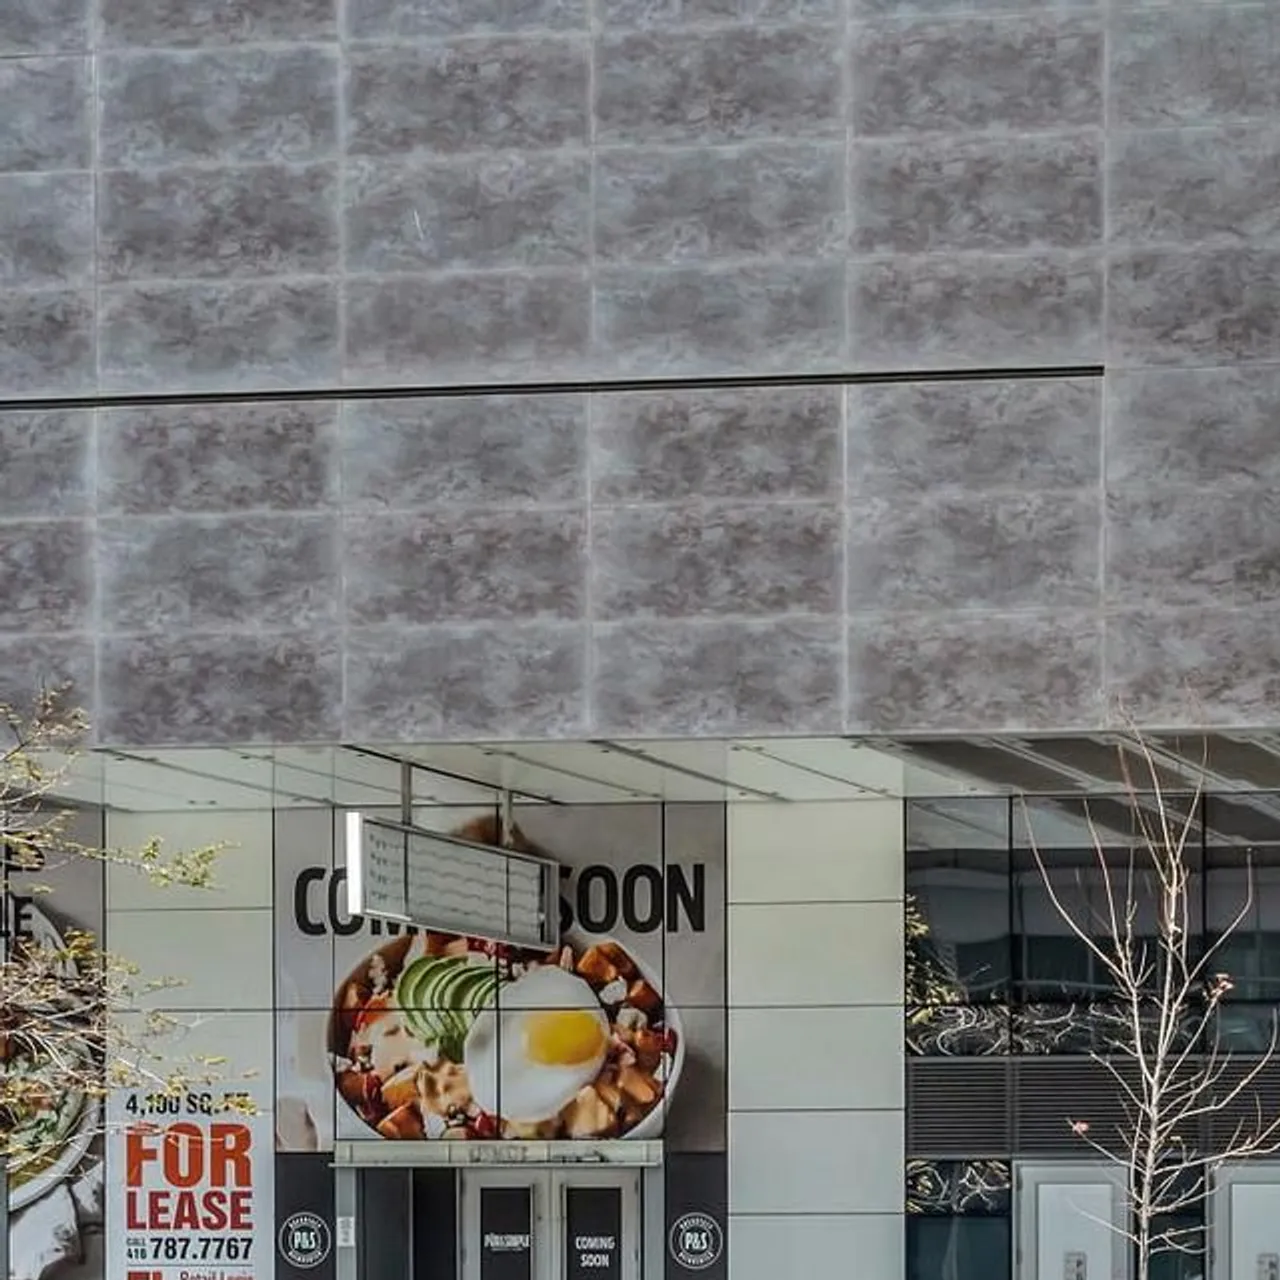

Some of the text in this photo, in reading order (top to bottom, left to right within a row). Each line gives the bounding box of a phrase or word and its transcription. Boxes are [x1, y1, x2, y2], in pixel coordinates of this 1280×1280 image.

[126, 1123, 253, 1187] FOR
[126, 1191, 254, 1230] LEASE
[150, 1237, 253, 1260] 787.7767
[575, 1236, 615, 1249] COMING
[685, 1232, 708, 1250] P&S
[580, 1254, 610, 1268] SOON
